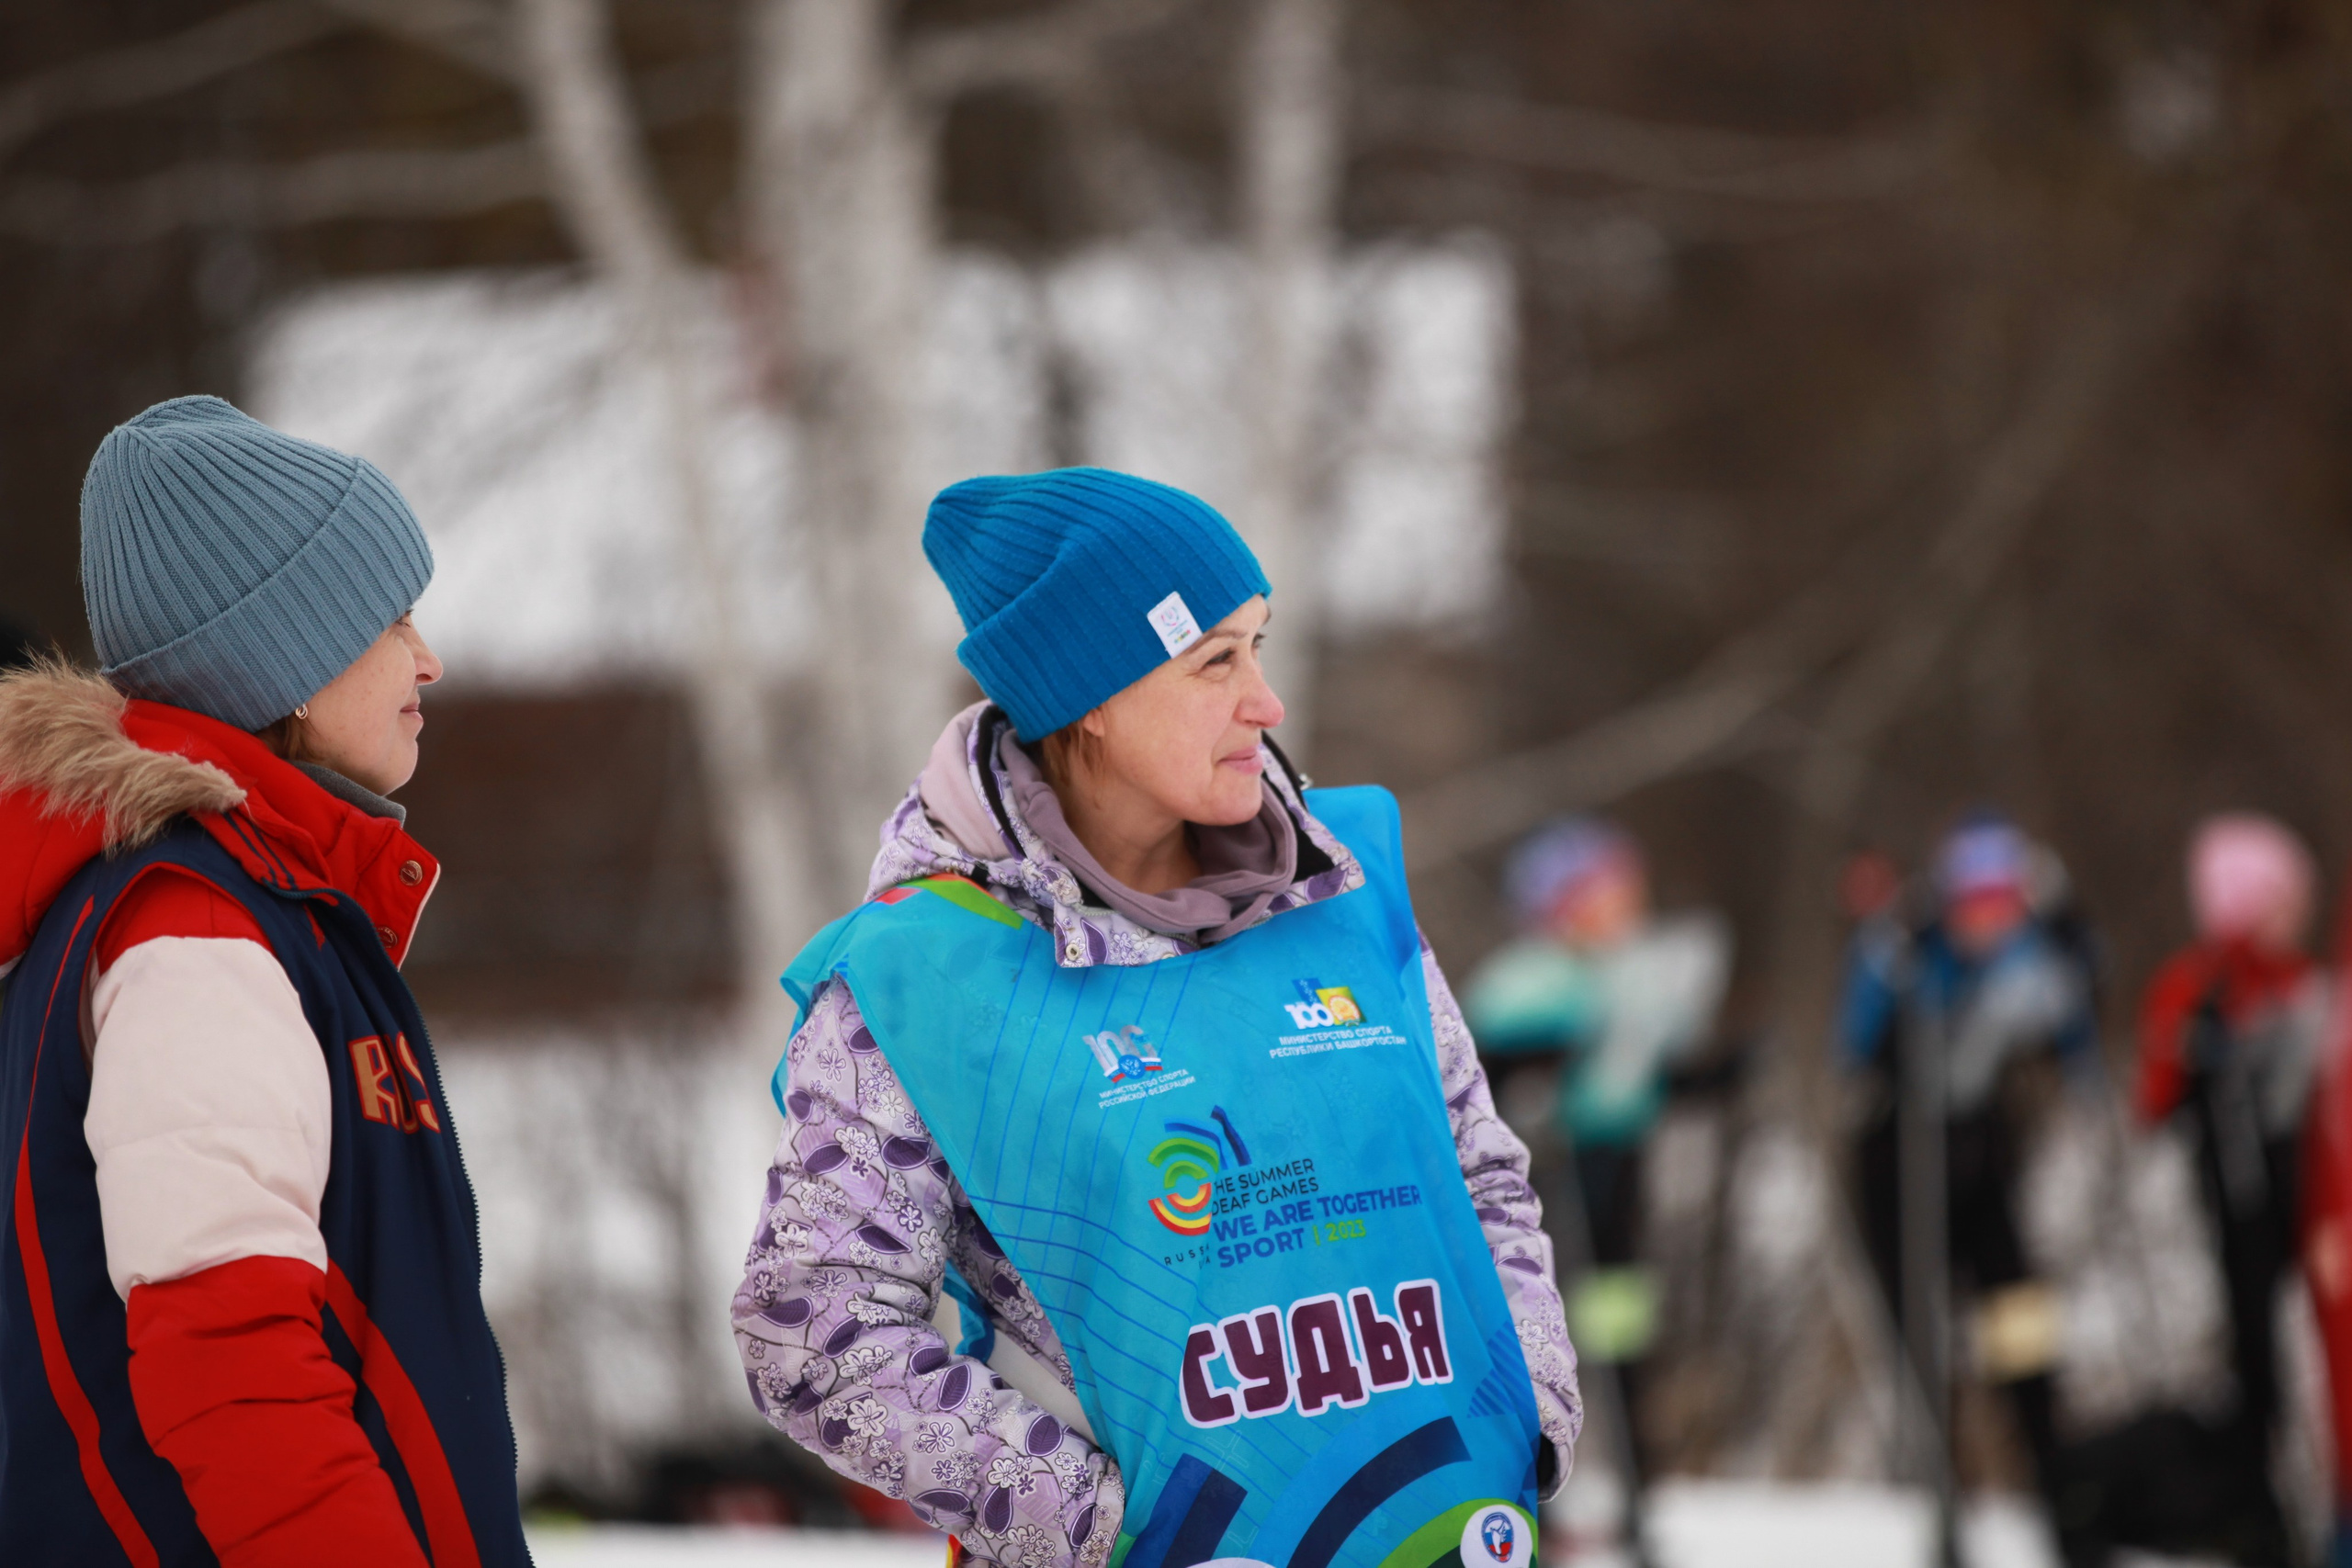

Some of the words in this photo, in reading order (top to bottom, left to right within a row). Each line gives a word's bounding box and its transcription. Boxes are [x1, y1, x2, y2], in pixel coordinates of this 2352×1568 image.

[1283, 1001, 1334, 1030] 100
[1269, 1043, 1334, 1058] РЕСПУБЛИКИ
[1335, 1035, 1408, 1050] БАШКОРТОСТАН
[1279, 1030, 1354, 1045] МИНИСТЕРСТВО
[1355, 1026, 1393, 1038] СПОРТА
[1098, 1090, 1148, 1109] РОССИЙСКОЙ
[1148, 1076, 1195, 1096] ФЕДЕРАЦИИ
[1099, 1078, 1158, 1099] МИНИСТЕРСТВО
[1158, 1068, 1189, 1083] СПОРТА
[1214, 1177, 1236, 1194] HE
[1238, 1157, 1316, 1190] SUMMER
[1255, 1176, 1319, 1204] GAMES
[1213, 1214, 1258, 1243] WE
[1263, 1200, 1314, 1232] ARE
[1317, 1185, 1423, 1217] TOGETHER
[1217, 1227, 1305, 1269] SPORT
[1325, 1218, 1367, 1242] 2023
[1181, 1279, 1453, 1427] СУДЬЯ
